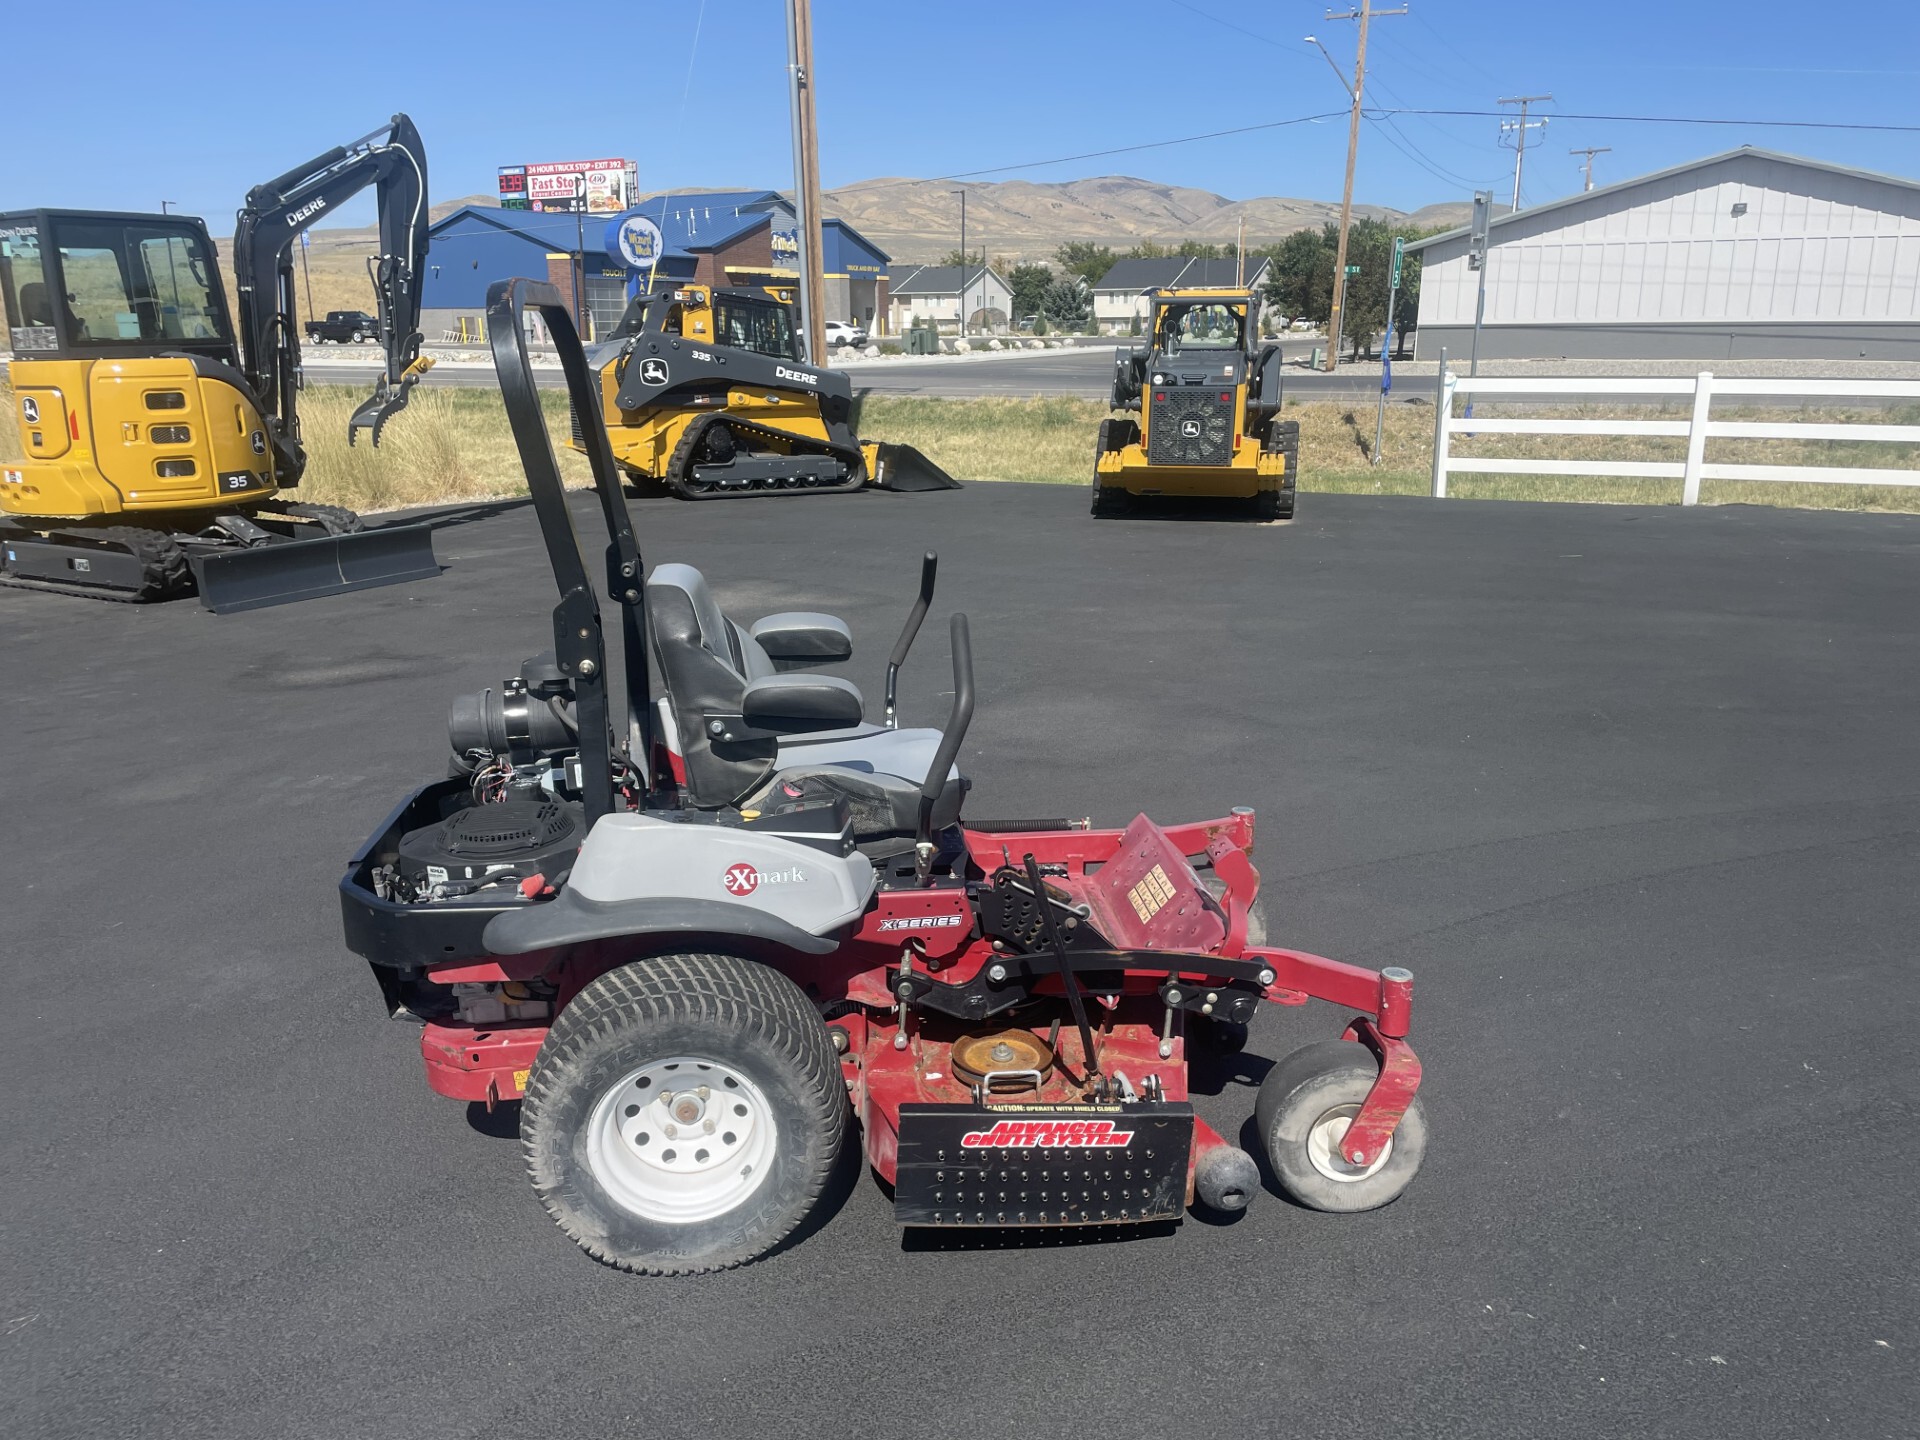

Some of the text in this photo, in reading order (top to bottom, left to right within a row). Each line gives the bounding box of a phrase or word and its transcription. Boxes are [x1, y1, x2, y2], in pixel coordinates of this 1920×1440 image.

[528, 160, 621, 174] 24 HOUR TRUCK STOP EXIT 392
[531, 177, 553, 190] Fast
[286, 195, 326, 227] DEERE
[15, 226, 38, 236] DEERE
[691, 350, 711, 362] 335
[775, 366, 818, 385] DEERE
[229, 475, 248, 488] 35
[723, 866, 805, 891] eXmark
[987, 1104, 1026, 1113] CAUTION:
[990, 1121, 1113, 1134] ADVANCED
[962, 1132, 1132, 1147] CHUTE SYSTEM
